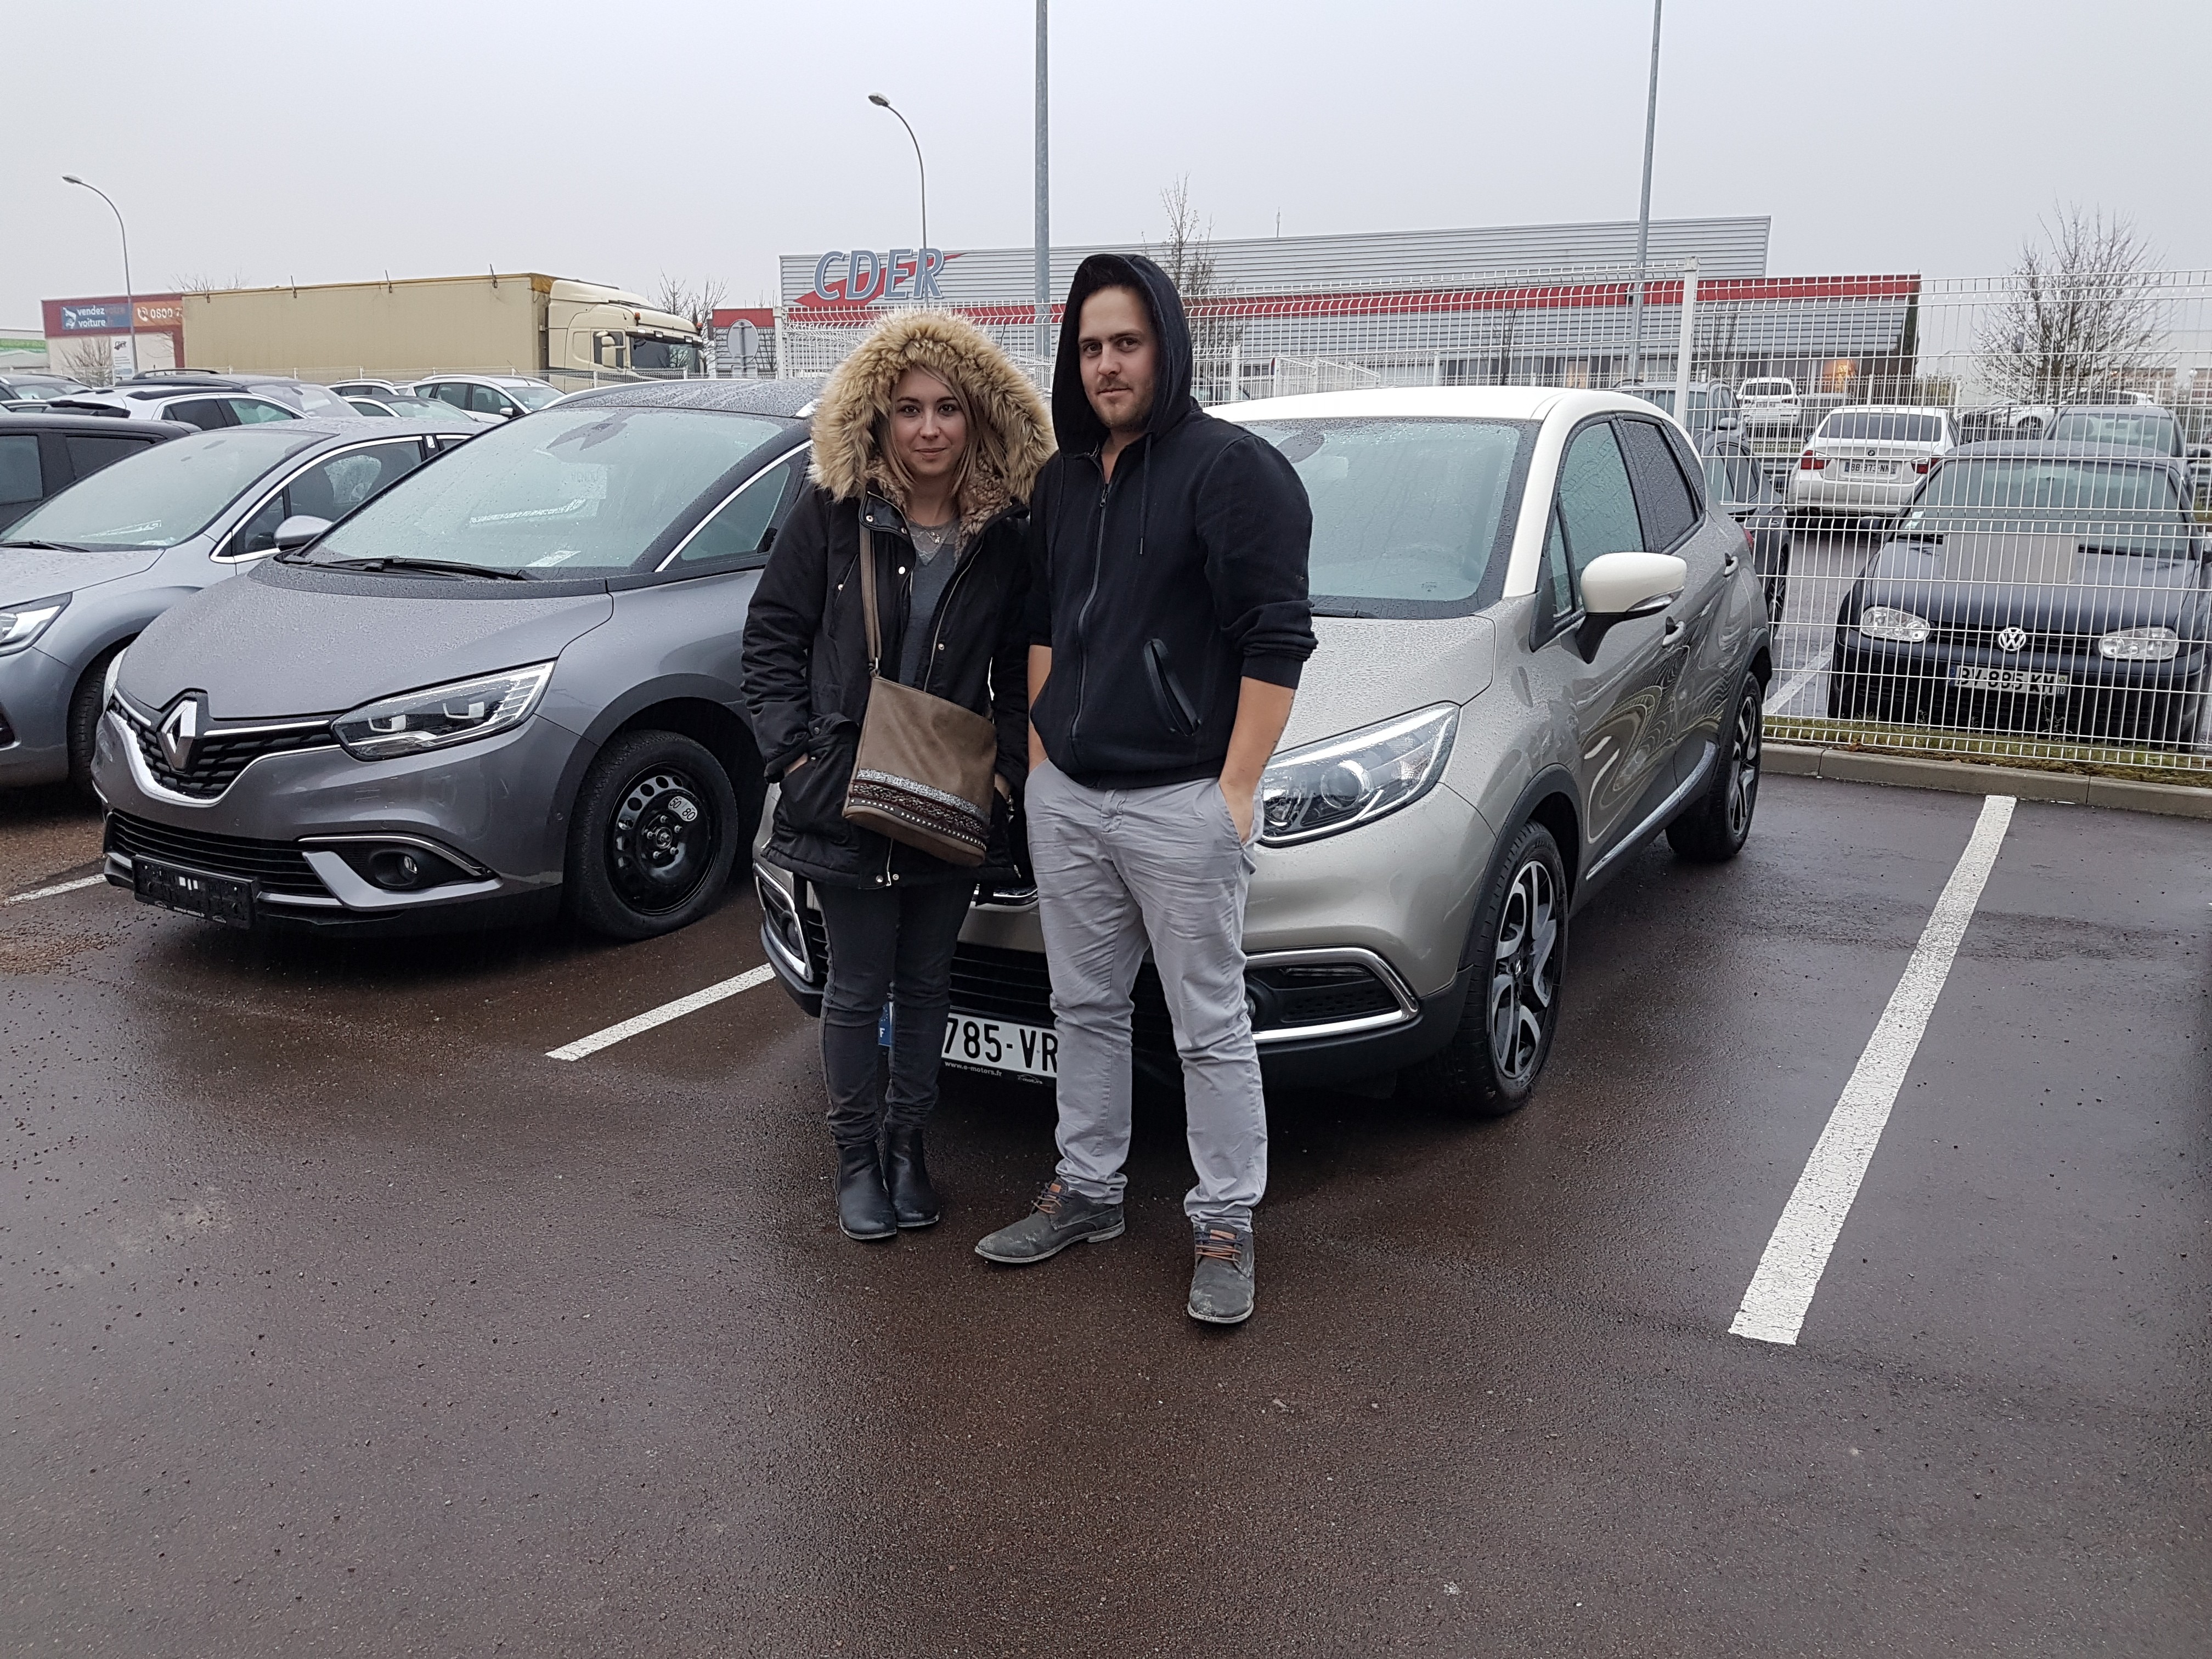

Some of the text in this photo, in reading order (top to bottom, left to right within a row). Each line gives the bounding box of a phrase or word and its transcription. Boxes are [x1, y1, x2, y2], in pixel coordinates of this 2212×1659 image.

[814, 248, 945, 300] CDER
[77, 305, 105, 316] vendez
[78, 318, 106, 328] voiture
[669, 798, 682, 809] 50
[682, 808, 696, 820] 80
[879, 1028, 885, 1038] F
[944, 1061, 1002, 1077] www.e-motors.fr
